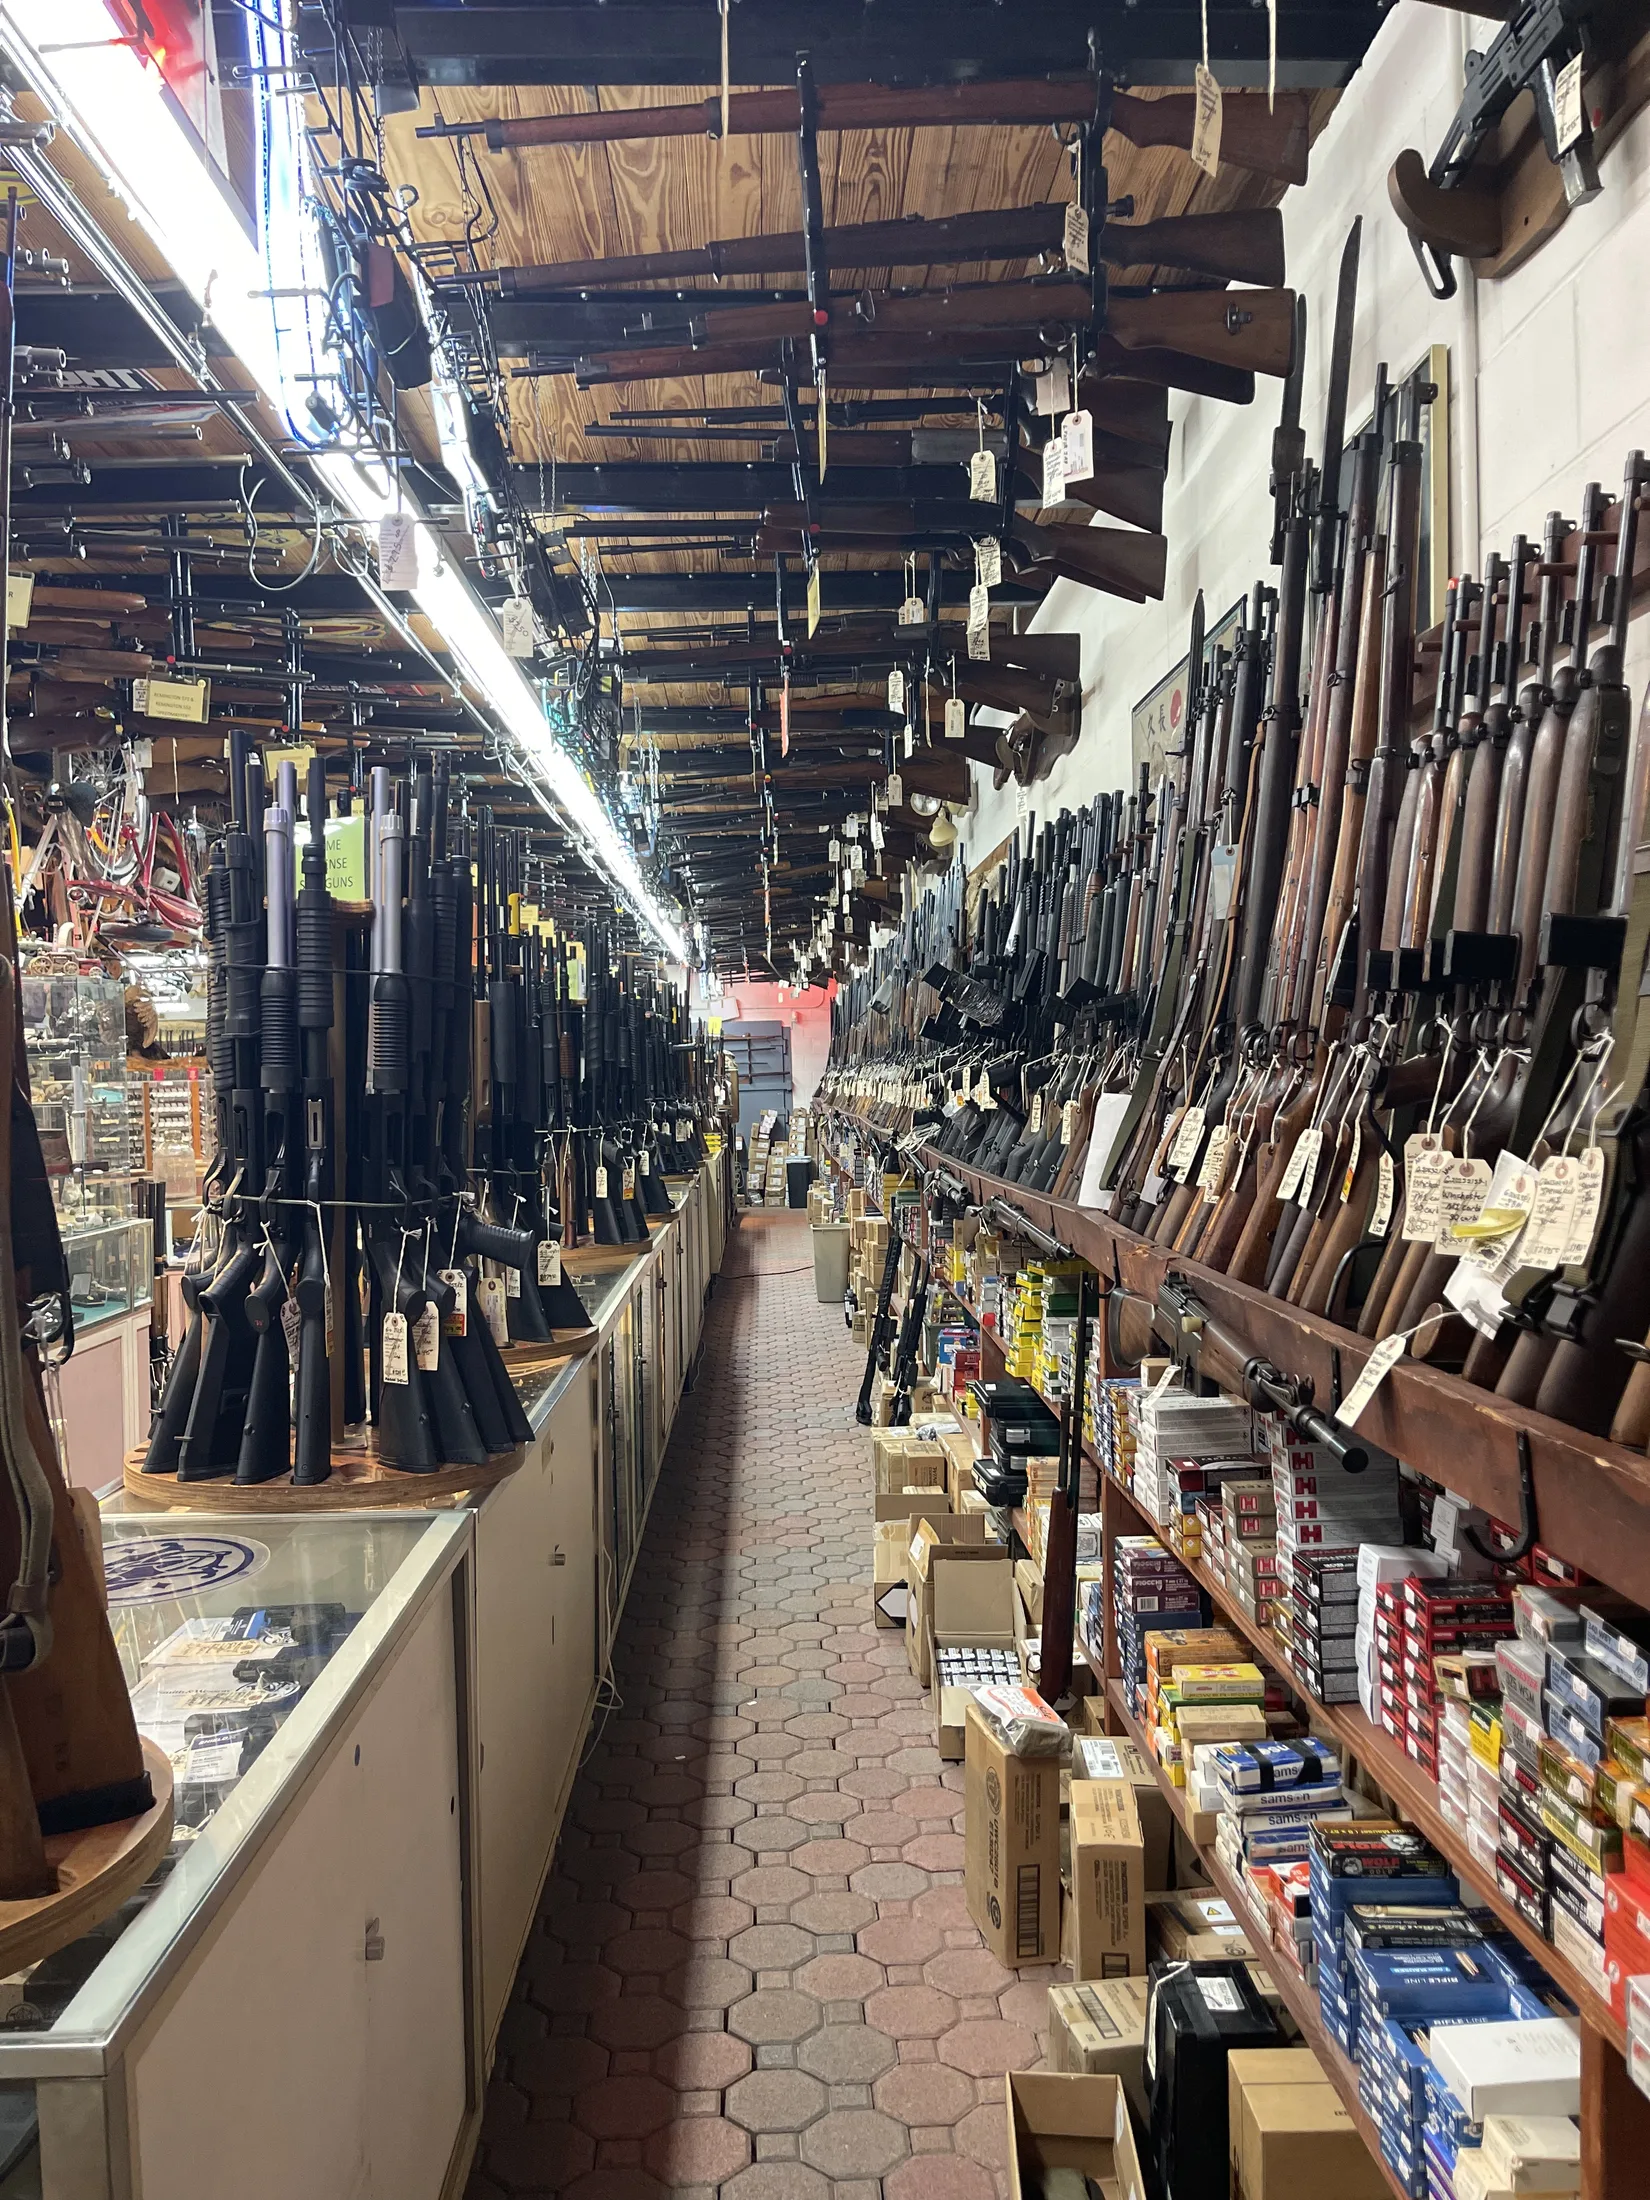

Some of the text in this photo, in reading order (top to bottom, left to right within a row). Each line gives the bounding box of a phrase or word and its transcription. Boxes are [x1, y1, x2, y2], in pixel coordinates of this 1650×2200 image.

[1442, 1190, 1486, 1200] Winchester
[1292, 1452, 1314, 1470] H
[1295, 1477, 1317, 1494] H
[1240, 1495, 1258, 1512] H
[1295, 1501, 1317, 1518] H
[1242, 1518, 1260, 1534] H
[1300, 1525, 1322, 1543] H
[1257, 1556, 1276, 1574] H
[1259, 1580, 1278, 1597] H
[1545, 1788, 1575, 1821] Remington
[1361, 1857, 1399, 1866] WOLF
